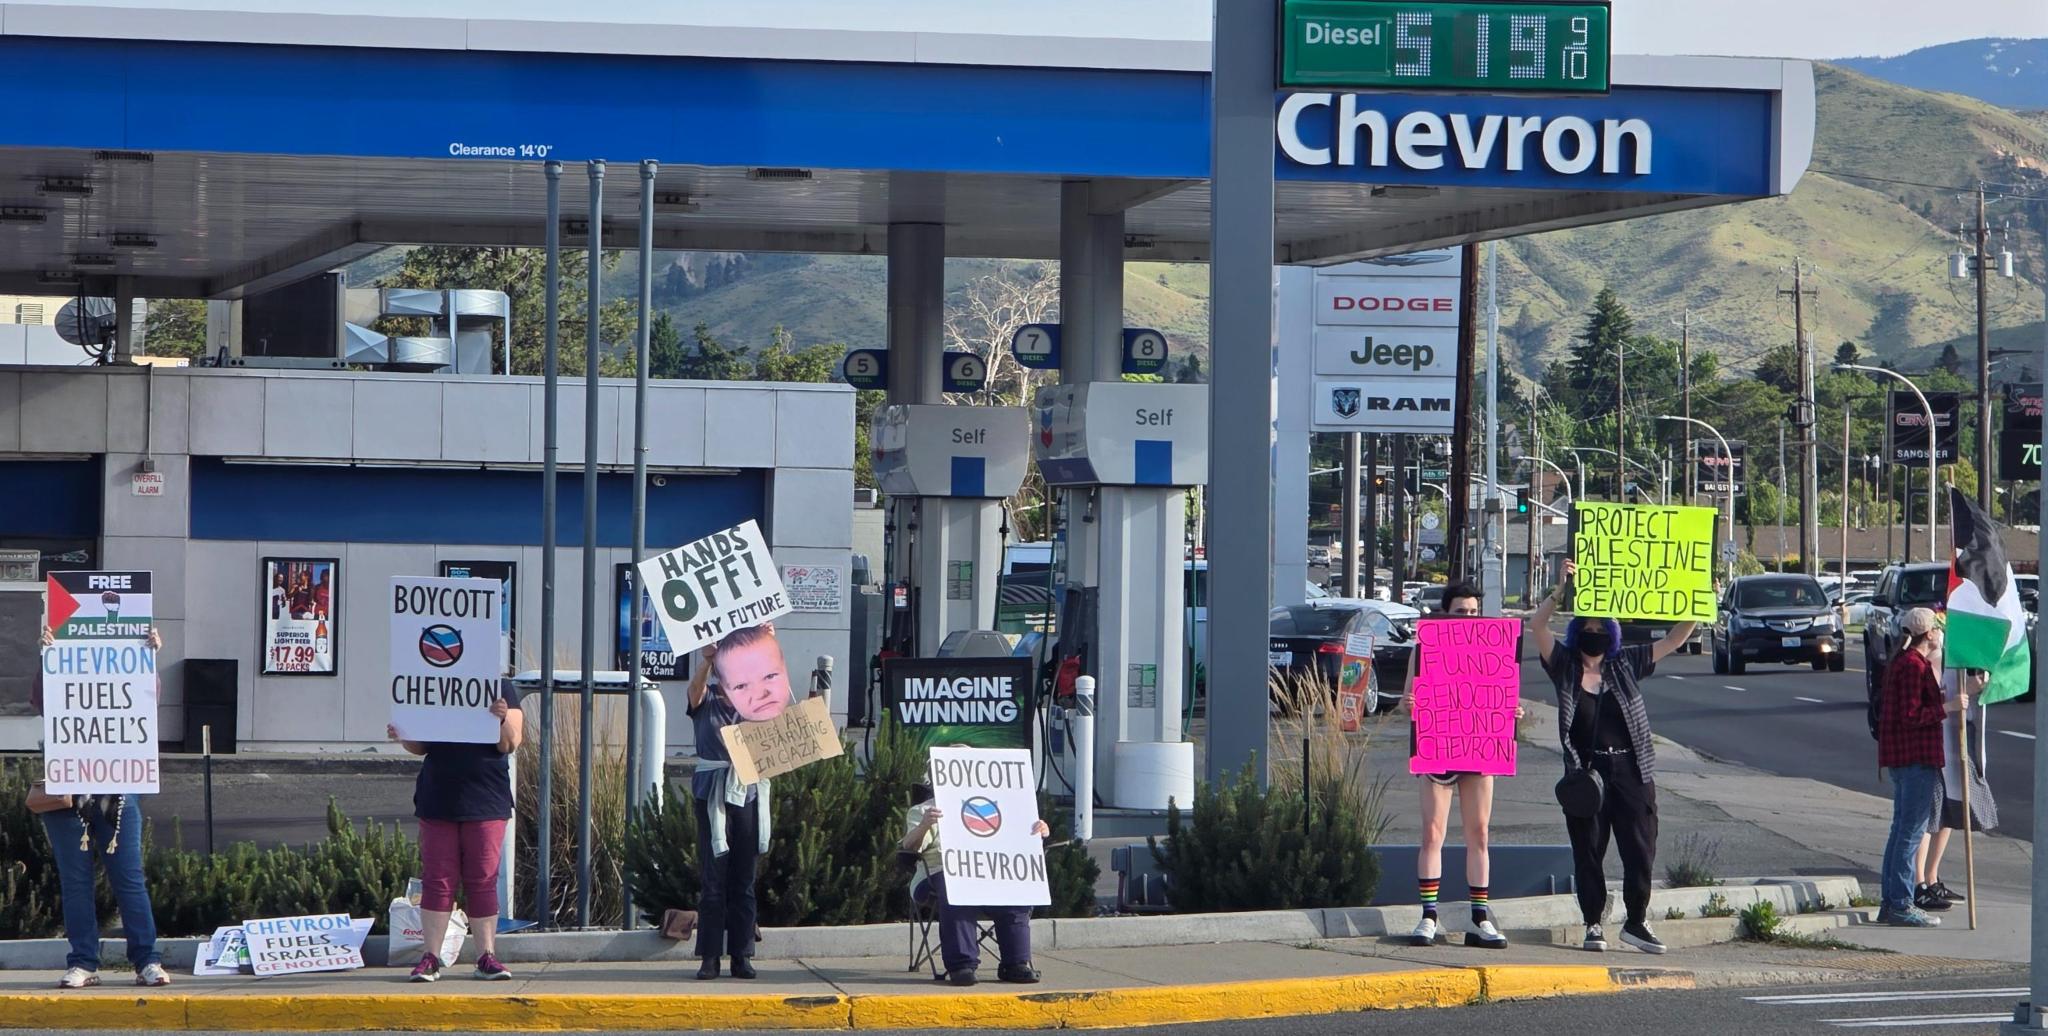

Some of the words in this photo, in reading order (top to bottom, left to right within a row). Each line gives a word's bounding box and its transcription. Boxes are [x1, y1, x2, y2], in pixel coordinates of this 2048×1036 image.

[1305, 22, 1380, 46] Diesel
[1277, 92, 1652, 175] Chevron
[449, 143, 516, 156] Clearance
[1333, 296, 1453, 312] DODGE
[1027, 333, 1040, 350] 7
[1141, 339, 1154, 355] 8
[1350, 336, 1434, 371] Jeep
[857, 358, 869, 374] 5
[961, 362, 974, 378] 6
[1367, 397, 1450, 411] RAM
[1135, 408, 1174, 427] Self
[1896, 412, 1950, 427] GMC
[951, 428, 986, 444] Self
[1897, 450, 1949, 459] SANGSER
[134, 474, 162, 483] OVERFILL
[1580, 506, 1679, 539] PROTECT
[658, 526, 748, 580] HANDS
[1576, 536, 1710, 572] PALESTINE
[88, 575, 132, 589] FREE
[661, 551, 762, 622] OFF!
[1578, 567, 1668, 590] DEFUND
[394, 584, 495, 619] BOYCOTT
[1576, 588, 1712, 617] GENOCIDE
[693, 616, 722, 640] MY
[727, 592, 785, 628] FUTURE
[68, 623, 149, 636] PALESTINE
[1417, 621, 1513, 648] CHEVRON
[43, 646, 154, 674] CHEVRON
[276, 663, 285, 671] 12
[286, 663, 310, 672] PACKS
[653, 666, 674, 676] Cans
[1423, 651, 1515, 680] FUNDS
[65, 682, 132, 710] FUELS
[392, 675, 498, 708] CHEVRON
[905, 676, 1013, 700] IMAGINE
[1415, 682, 1518, 711] GENOCIDE
[900, 700, 1018, 724] WINNING
[1417, 708, 1506, 736] DEFUND
[52, 717, 148, 744] ISRAEL'S
[760, 721, 828, 752] STARVING
[1417, 735, 1514, 762] CHEVRON!
[47, 758, 157, 784] GENOCIDE
[755, 756, 776, 773] IN
[934, 758, 1025, 789] BOYCOTT
[944, 849, 1045, 882] CHEVRON
[246, 915, 350, 935] CHEVRON
[260, 944, 352, 962] ISRAEL'S
[266, 933, 331, 949] FUELS
[256, 955, 361, 972] GENOCIDE
